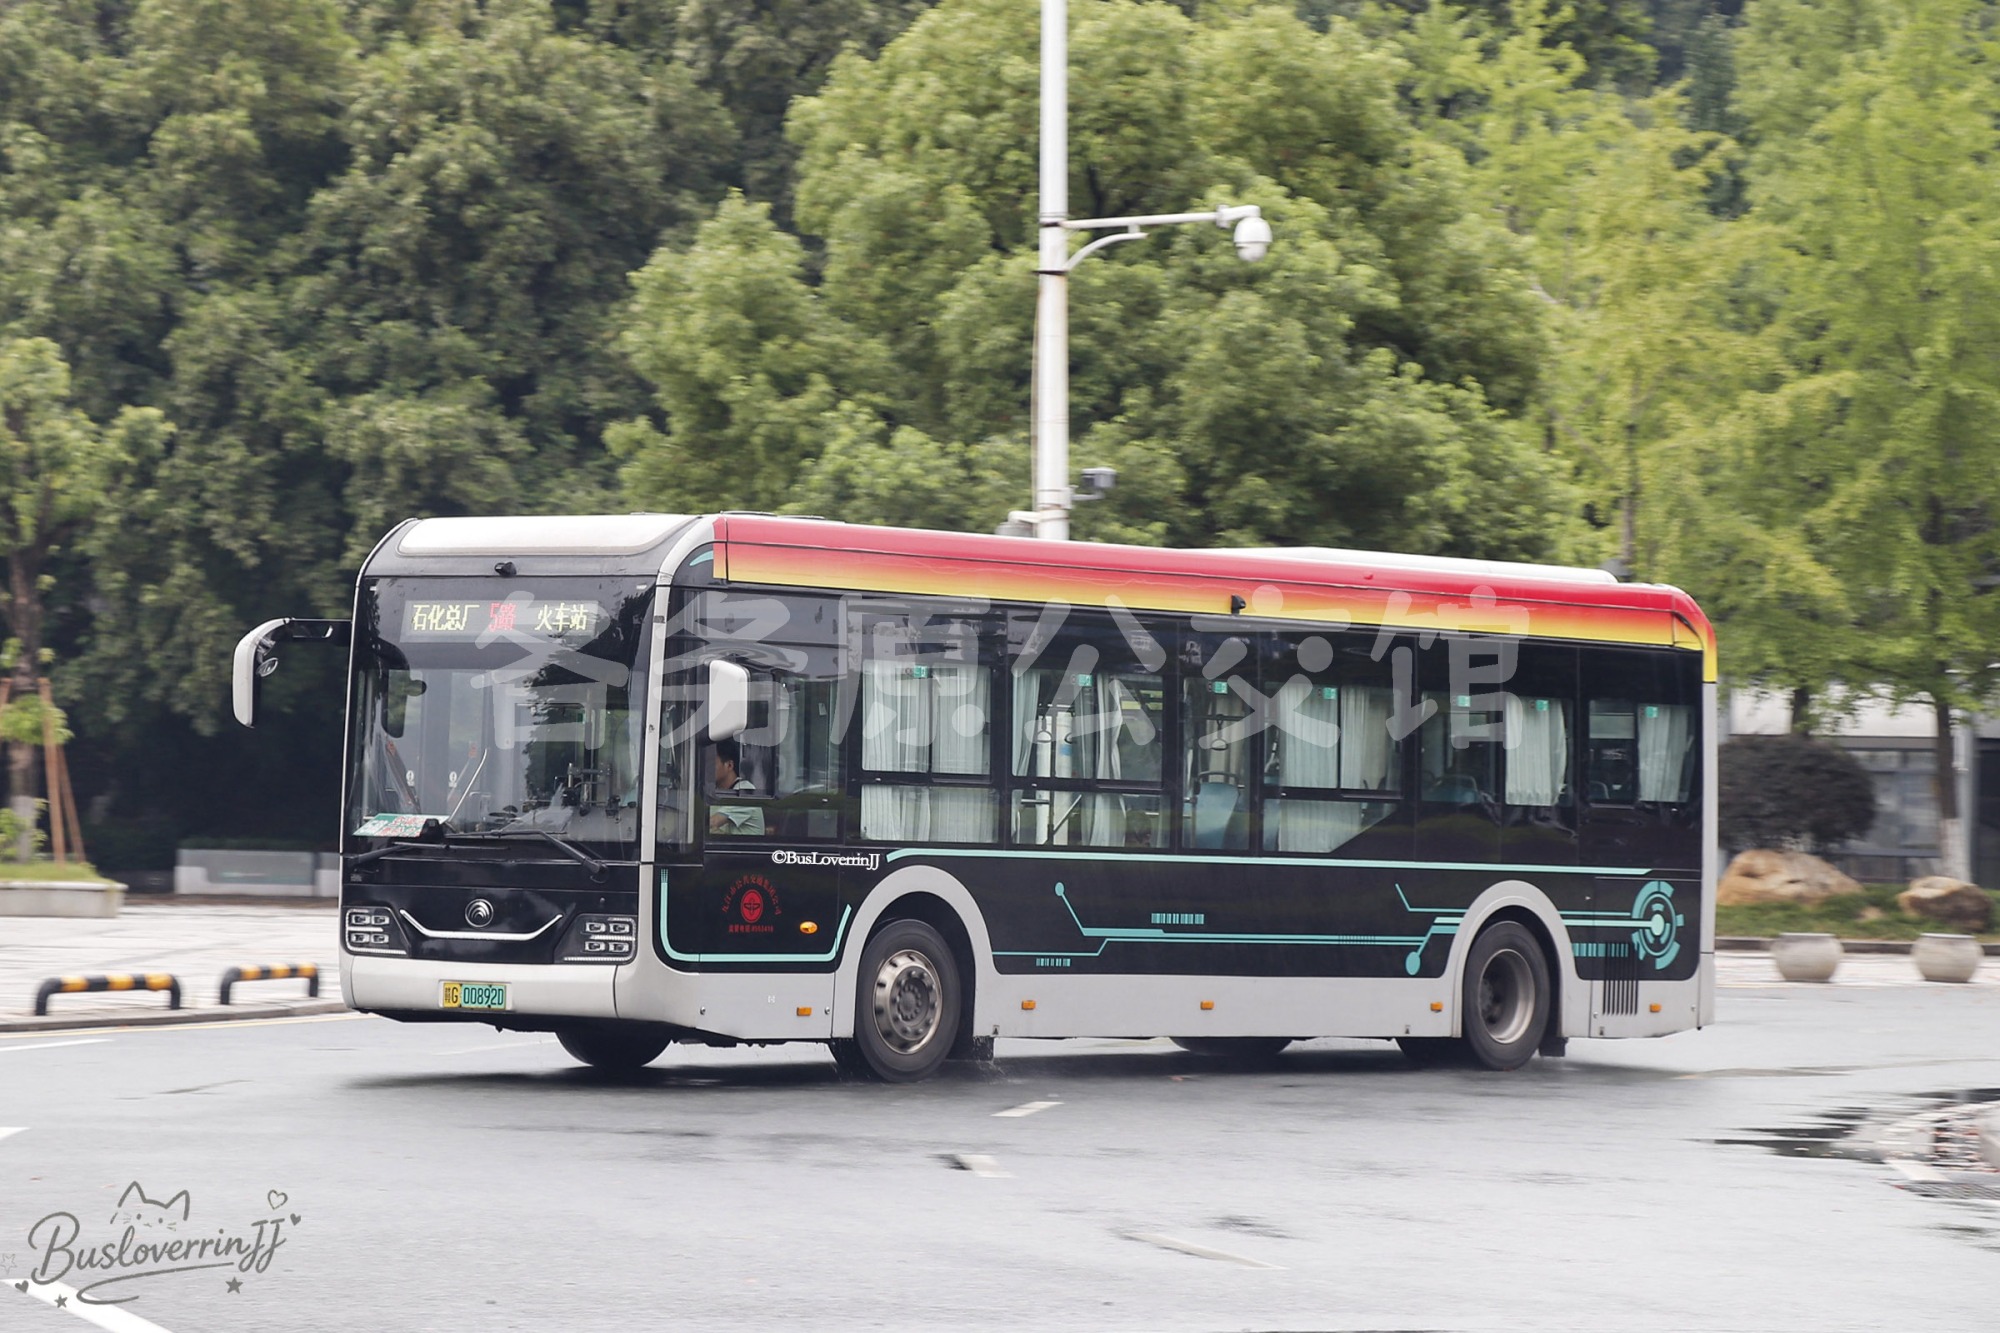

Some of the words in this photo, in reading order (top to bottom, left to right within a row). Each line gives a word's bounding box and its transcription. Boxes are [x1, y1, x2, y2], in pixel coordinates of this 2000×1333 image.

[412, 604, 480, 631] 石化总厂
[534, 602, 590, 632] 火车站
